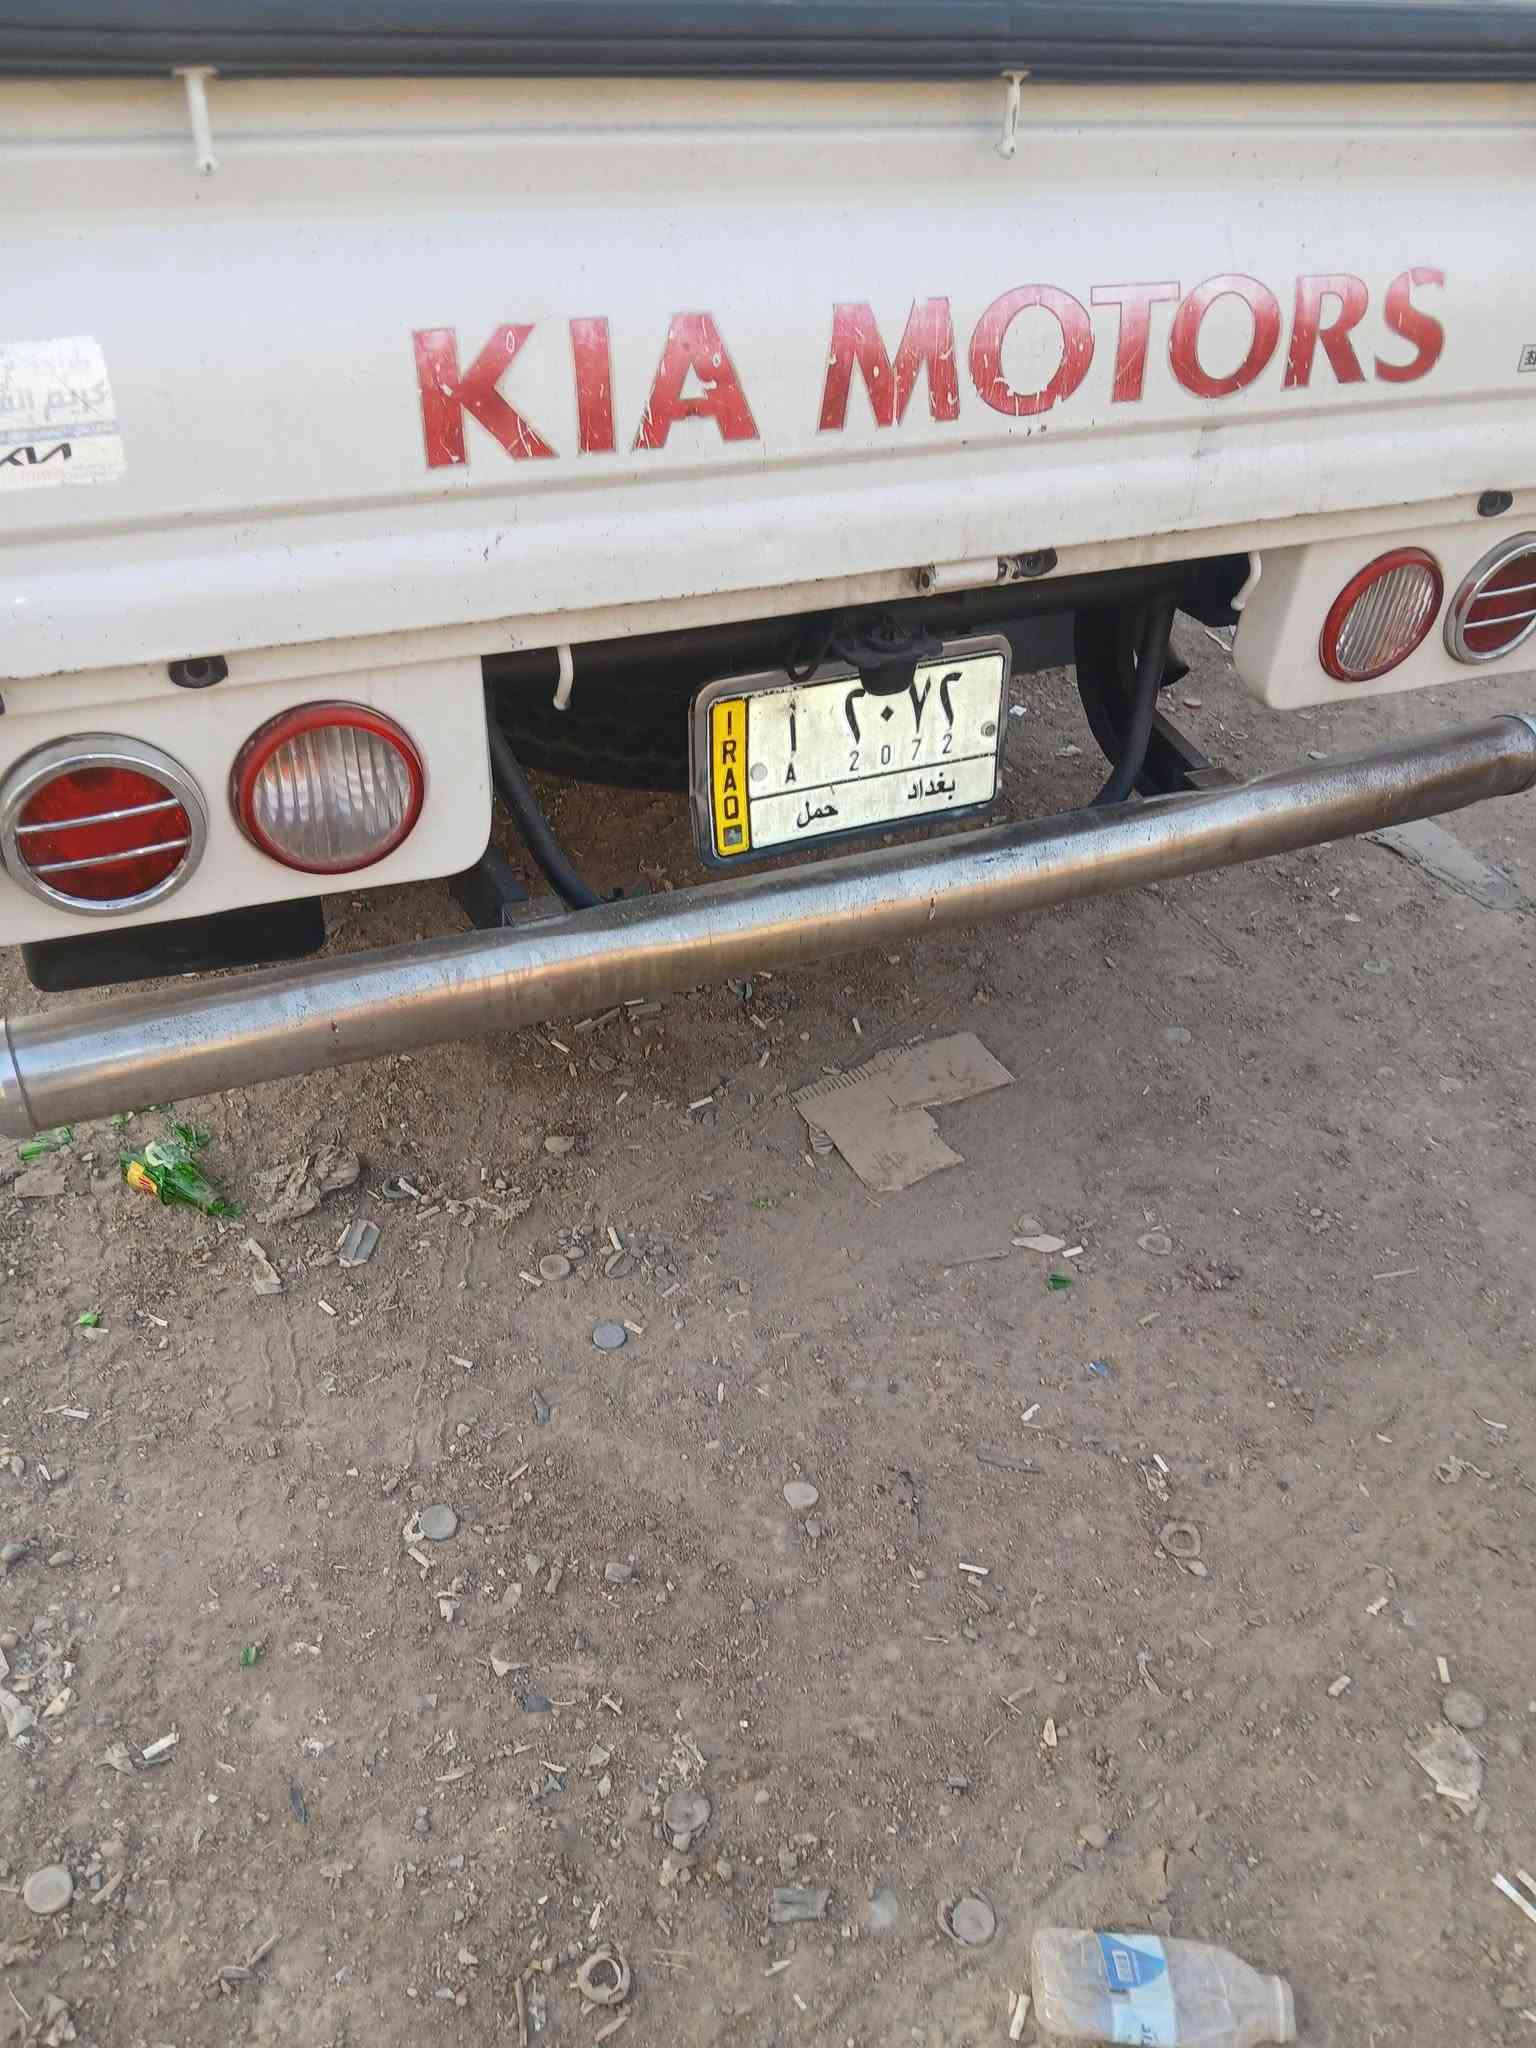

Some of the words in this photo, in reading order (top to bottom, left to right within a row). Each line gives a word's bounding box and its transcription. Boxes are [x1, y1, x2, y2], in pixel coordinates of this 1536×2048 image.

[411, 311, 762, 469] KIA
[817, 266, 1446, 432] MOTORS
[721, 711, 740, 820] IRAQ
[784, 762, 797, 785] A
[848, 733, 953, 771] 2072
[907, 771, 957, 801] بغداد
[795, 800, 840, 829] حمل
